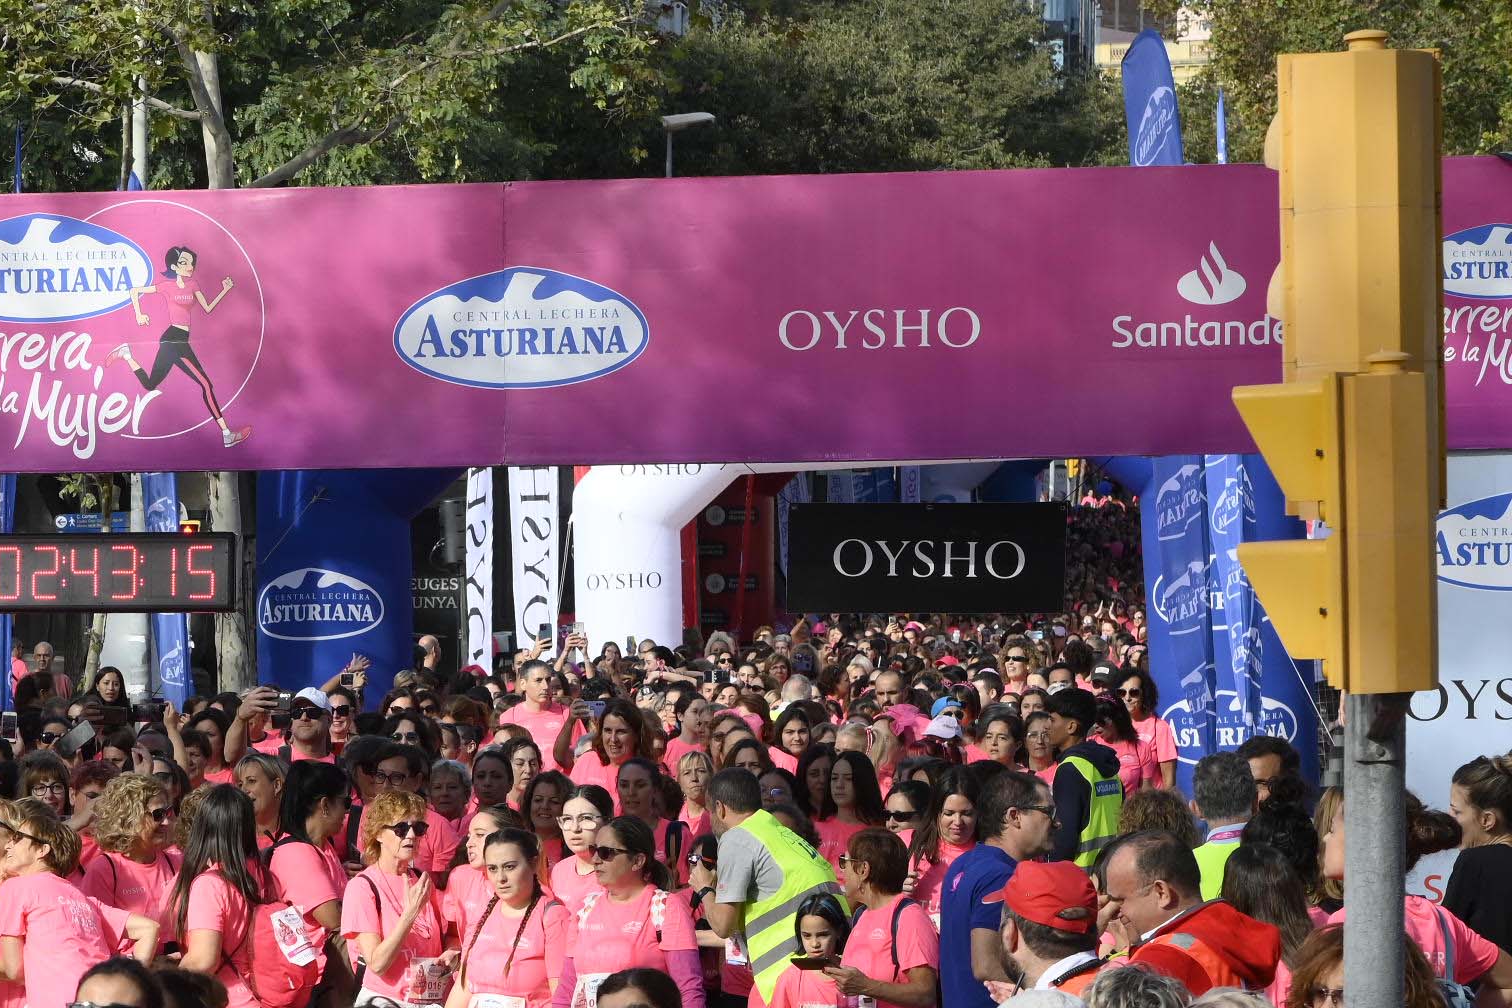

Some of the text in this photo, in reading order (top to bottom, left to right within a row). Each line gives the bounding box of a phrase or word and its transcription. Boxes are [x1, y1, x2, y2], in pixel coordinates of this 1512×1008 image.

[55, 249, 128, 262] LECHERA
[1452, 249, 1503, 259] CENTRAL
[453, 307, 621, 322] CENTRAL LECHERA
[413, 313, 629, 358] ASTURIANA
[778, 307, 981, 351] OYSHO
[1111, 314, 1284, 348] Santande
[1461, 336, 1479, 363] la
[14, 367, 163, 460] Mujer
[1459, 528, 1512, 537] CENTRA
[832, 538, 1026, 580] OYSHO
[586, 571, 662, 591] OYSHO
[262, 597, 375, 625] ASTURIANA
